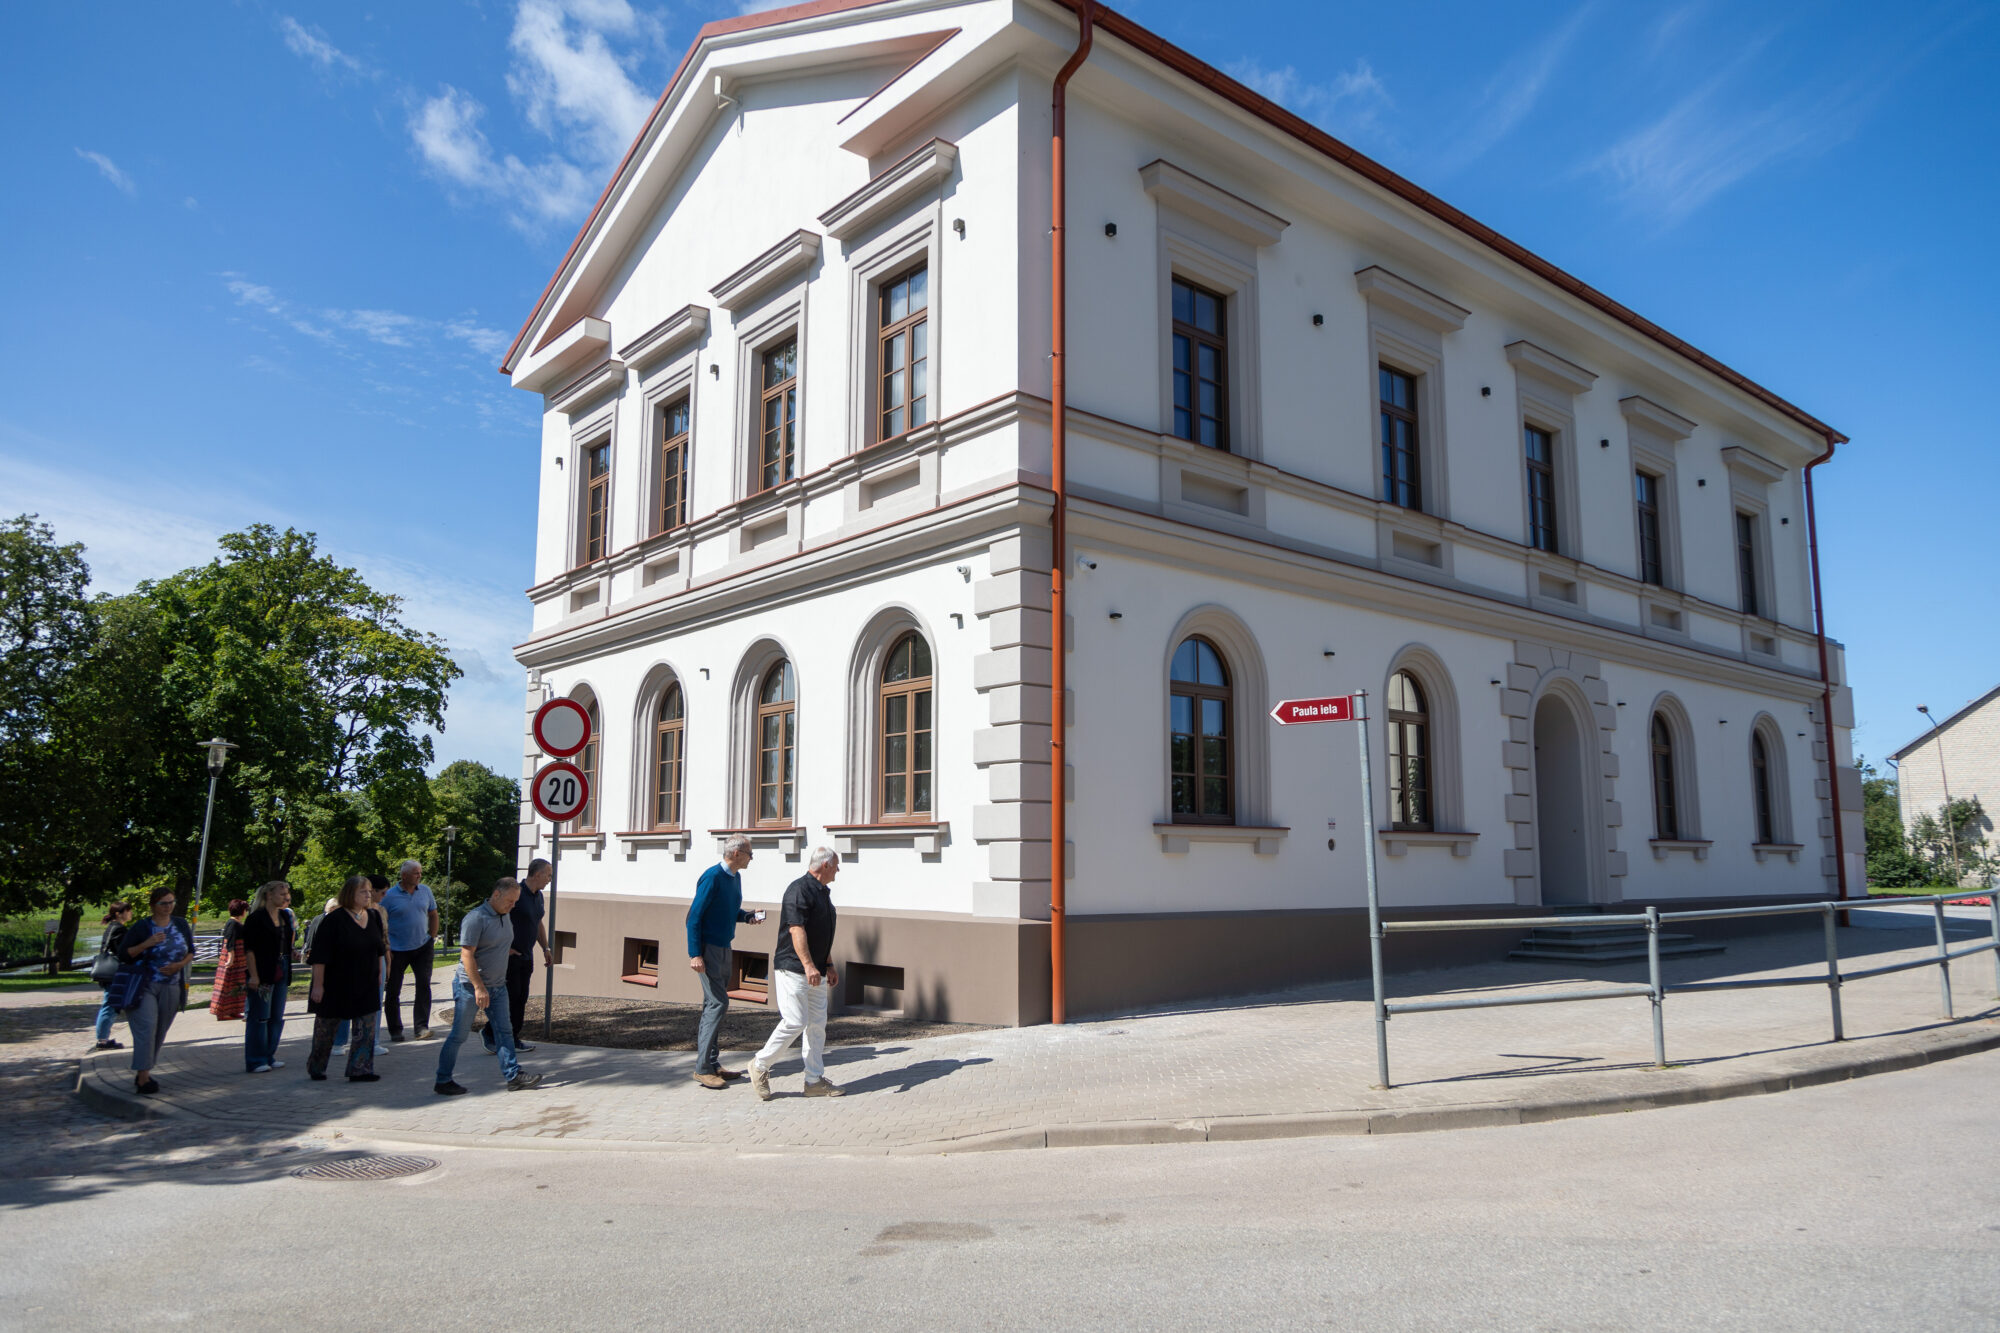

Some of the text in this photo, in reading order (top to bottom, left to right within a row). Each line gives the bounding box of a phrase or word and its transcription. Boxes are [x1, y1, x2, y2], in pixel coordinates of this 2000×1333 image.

[1292, 704, 1338, 717] Paula iela
[548, 777, 575, 806] 20
